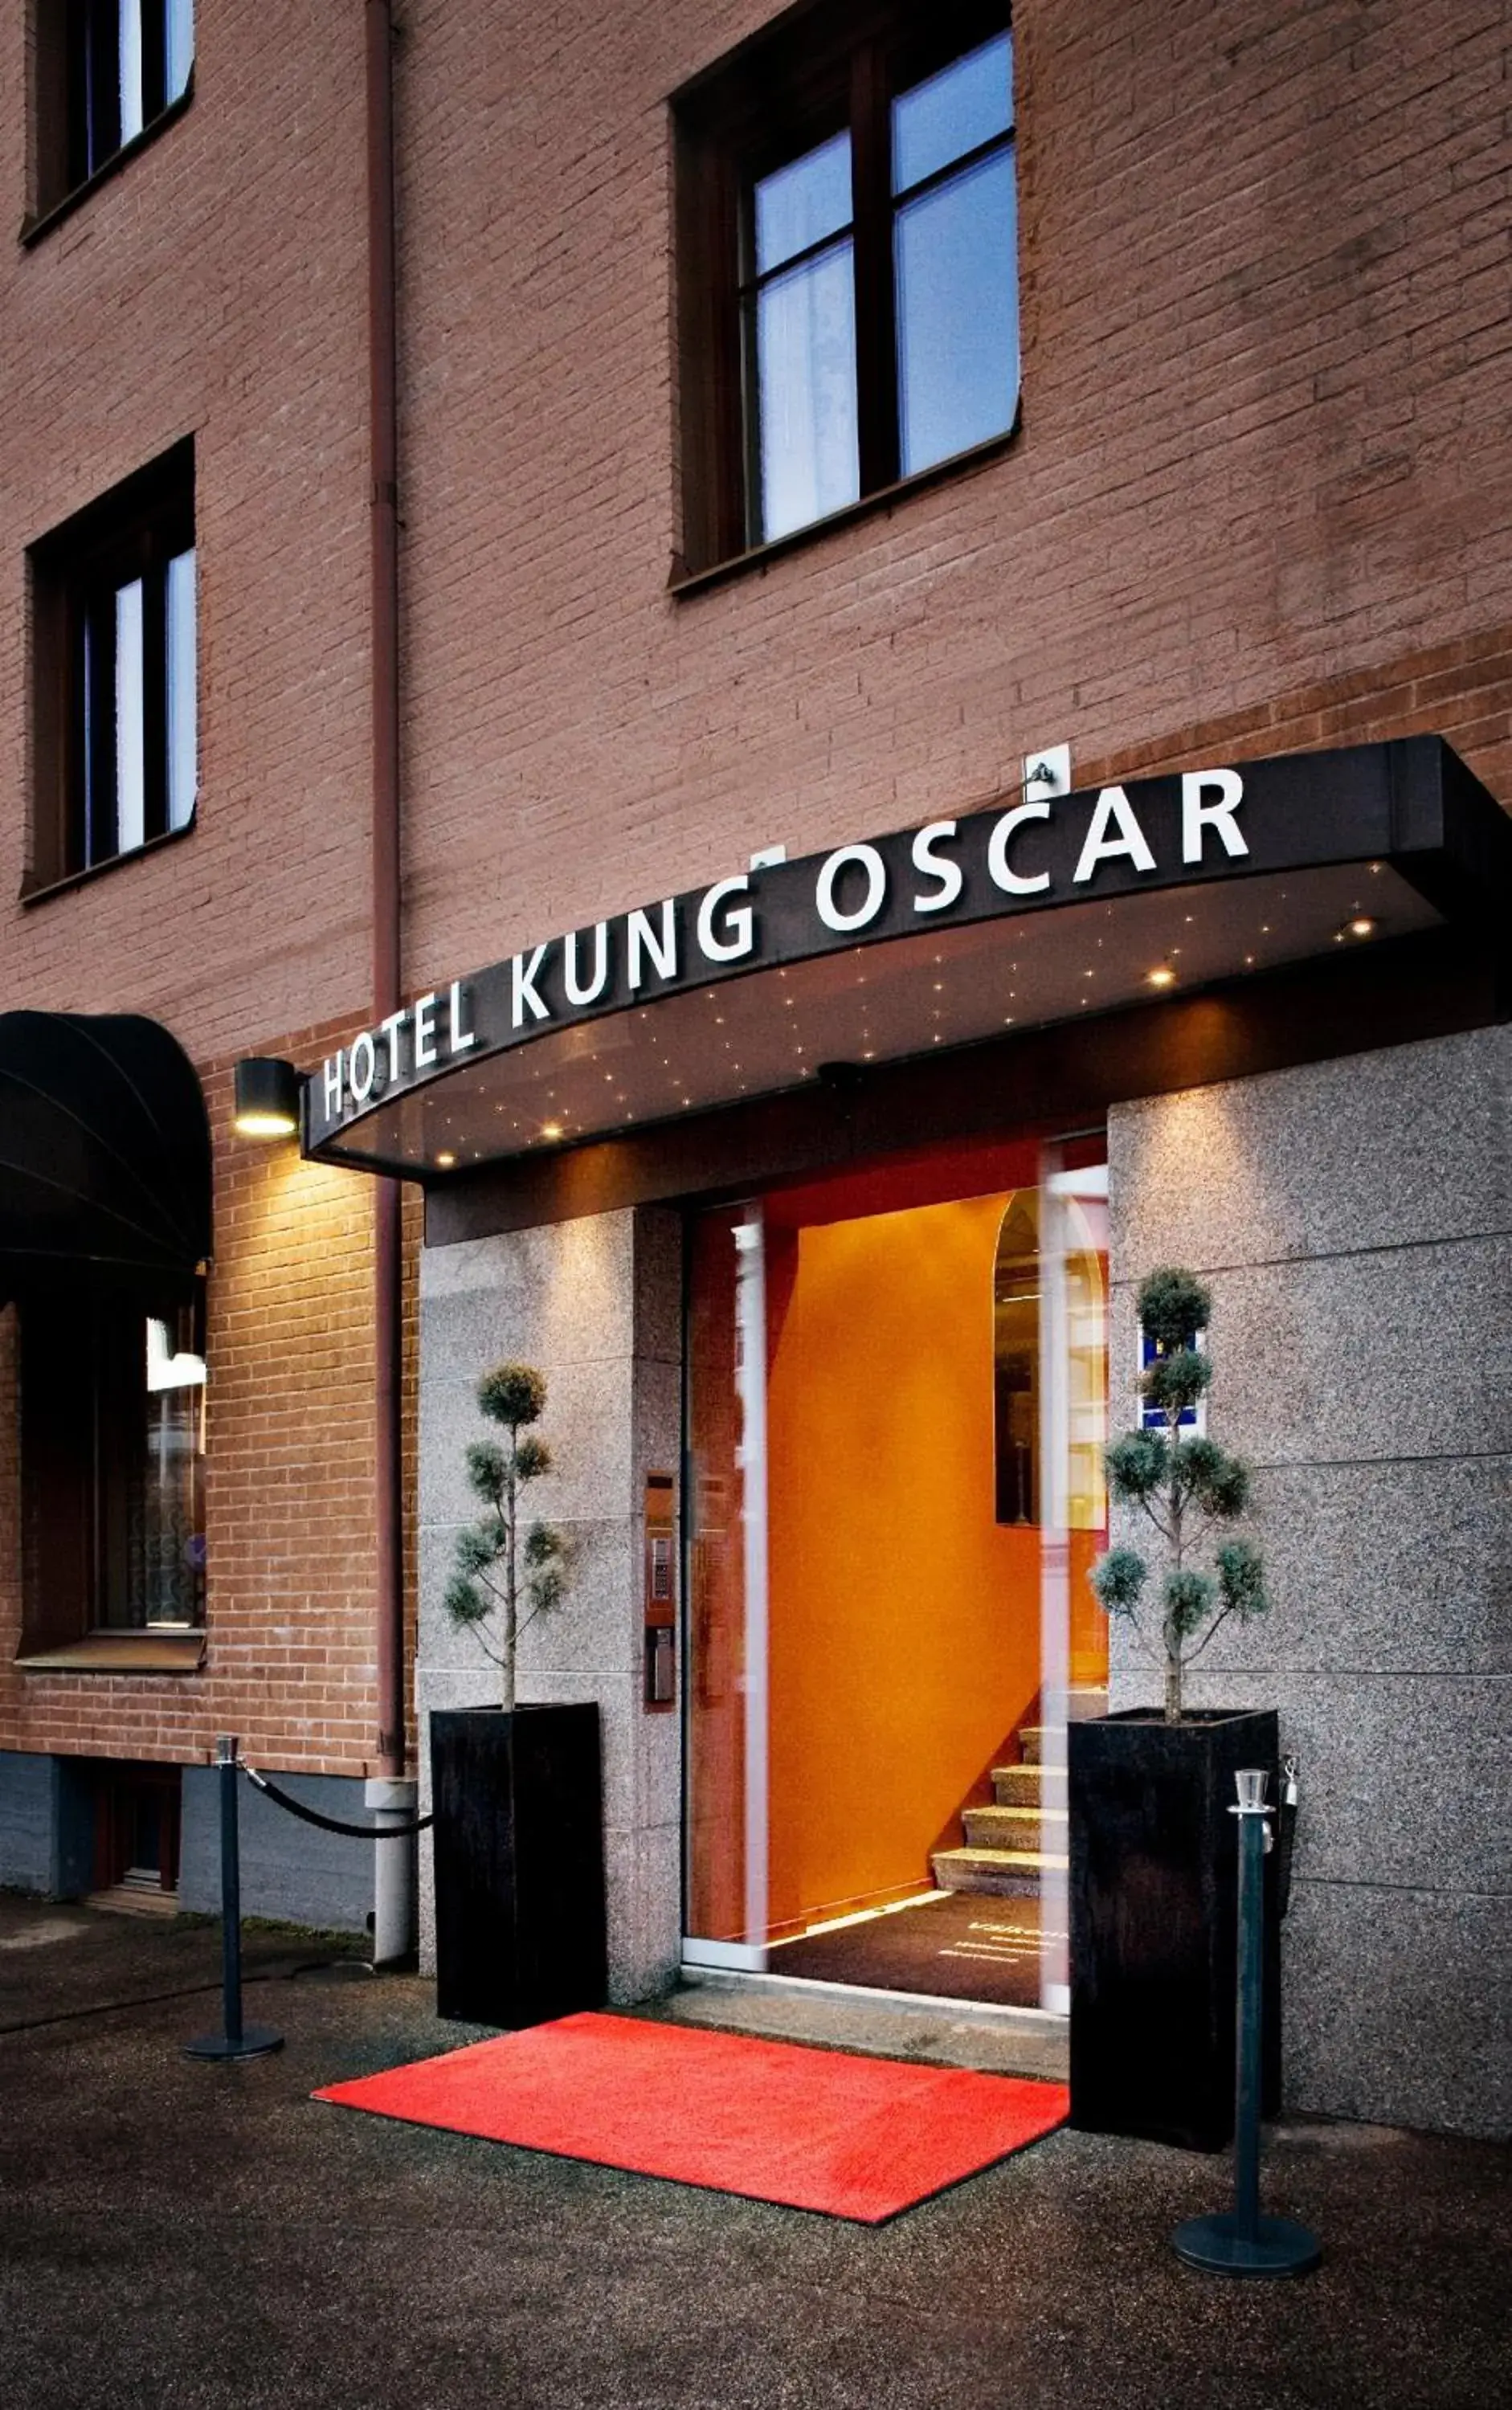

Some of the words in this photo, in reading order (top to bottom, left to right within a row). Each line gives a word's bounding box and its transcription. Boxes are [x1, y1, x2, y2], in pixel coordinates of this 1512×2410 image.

[324, 981, 474, 1122] HOTEL
[512, 875, 753, 1029] KUNG
[815, 769, 1249, 931] OSCAR
